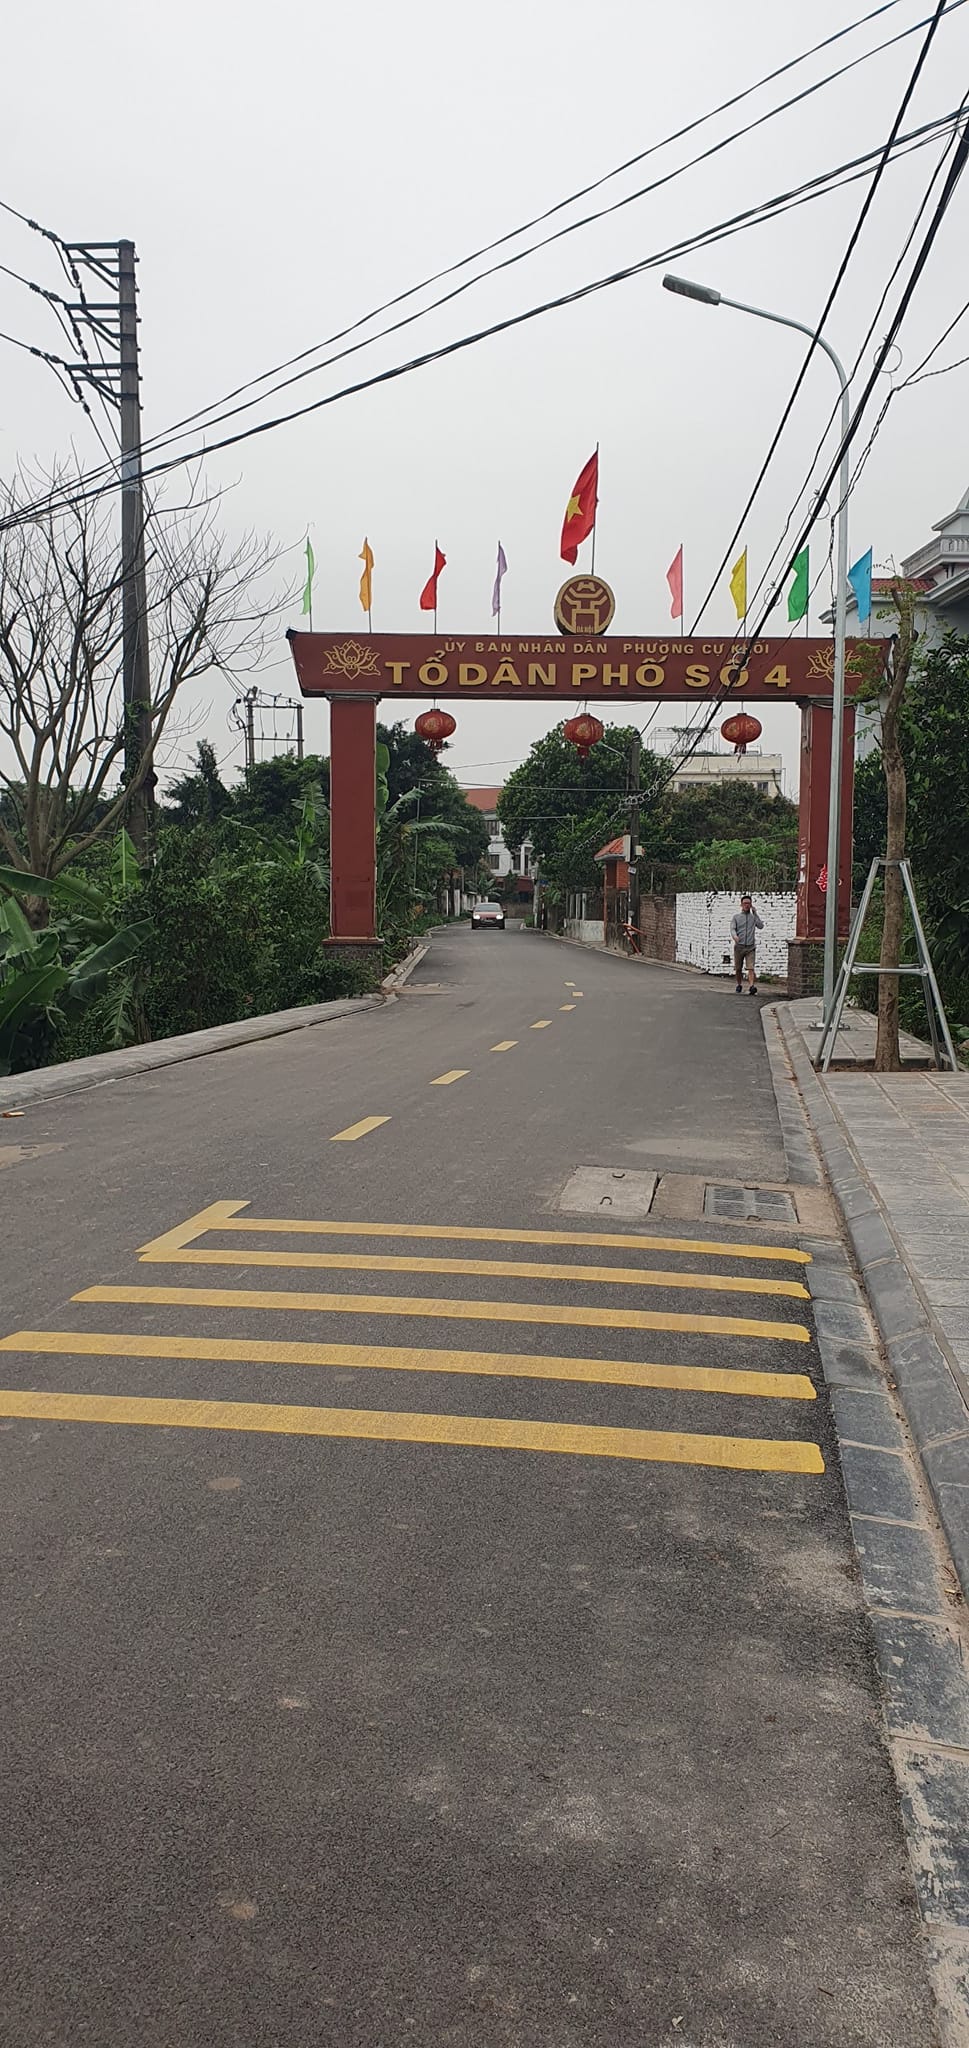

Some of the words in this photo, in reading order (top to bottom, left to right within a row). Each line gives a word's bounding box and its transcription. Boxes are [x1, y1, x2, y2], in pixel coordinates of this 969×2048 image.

[475, 642, 512, 653] BAN
[518, 640, 566, 653] NHÂN
[573, 640, 608, 654] DÂN
[623, 640, 694, 655] PHƯỜNG
[702, 643, 725, 657] CỰ
[384, 650, 449, 686] TỔ
[458, 657, 557, 686] DÂN
[571, 655, 669, 687] PHỐ
[764, 665, 791, 688] 4
